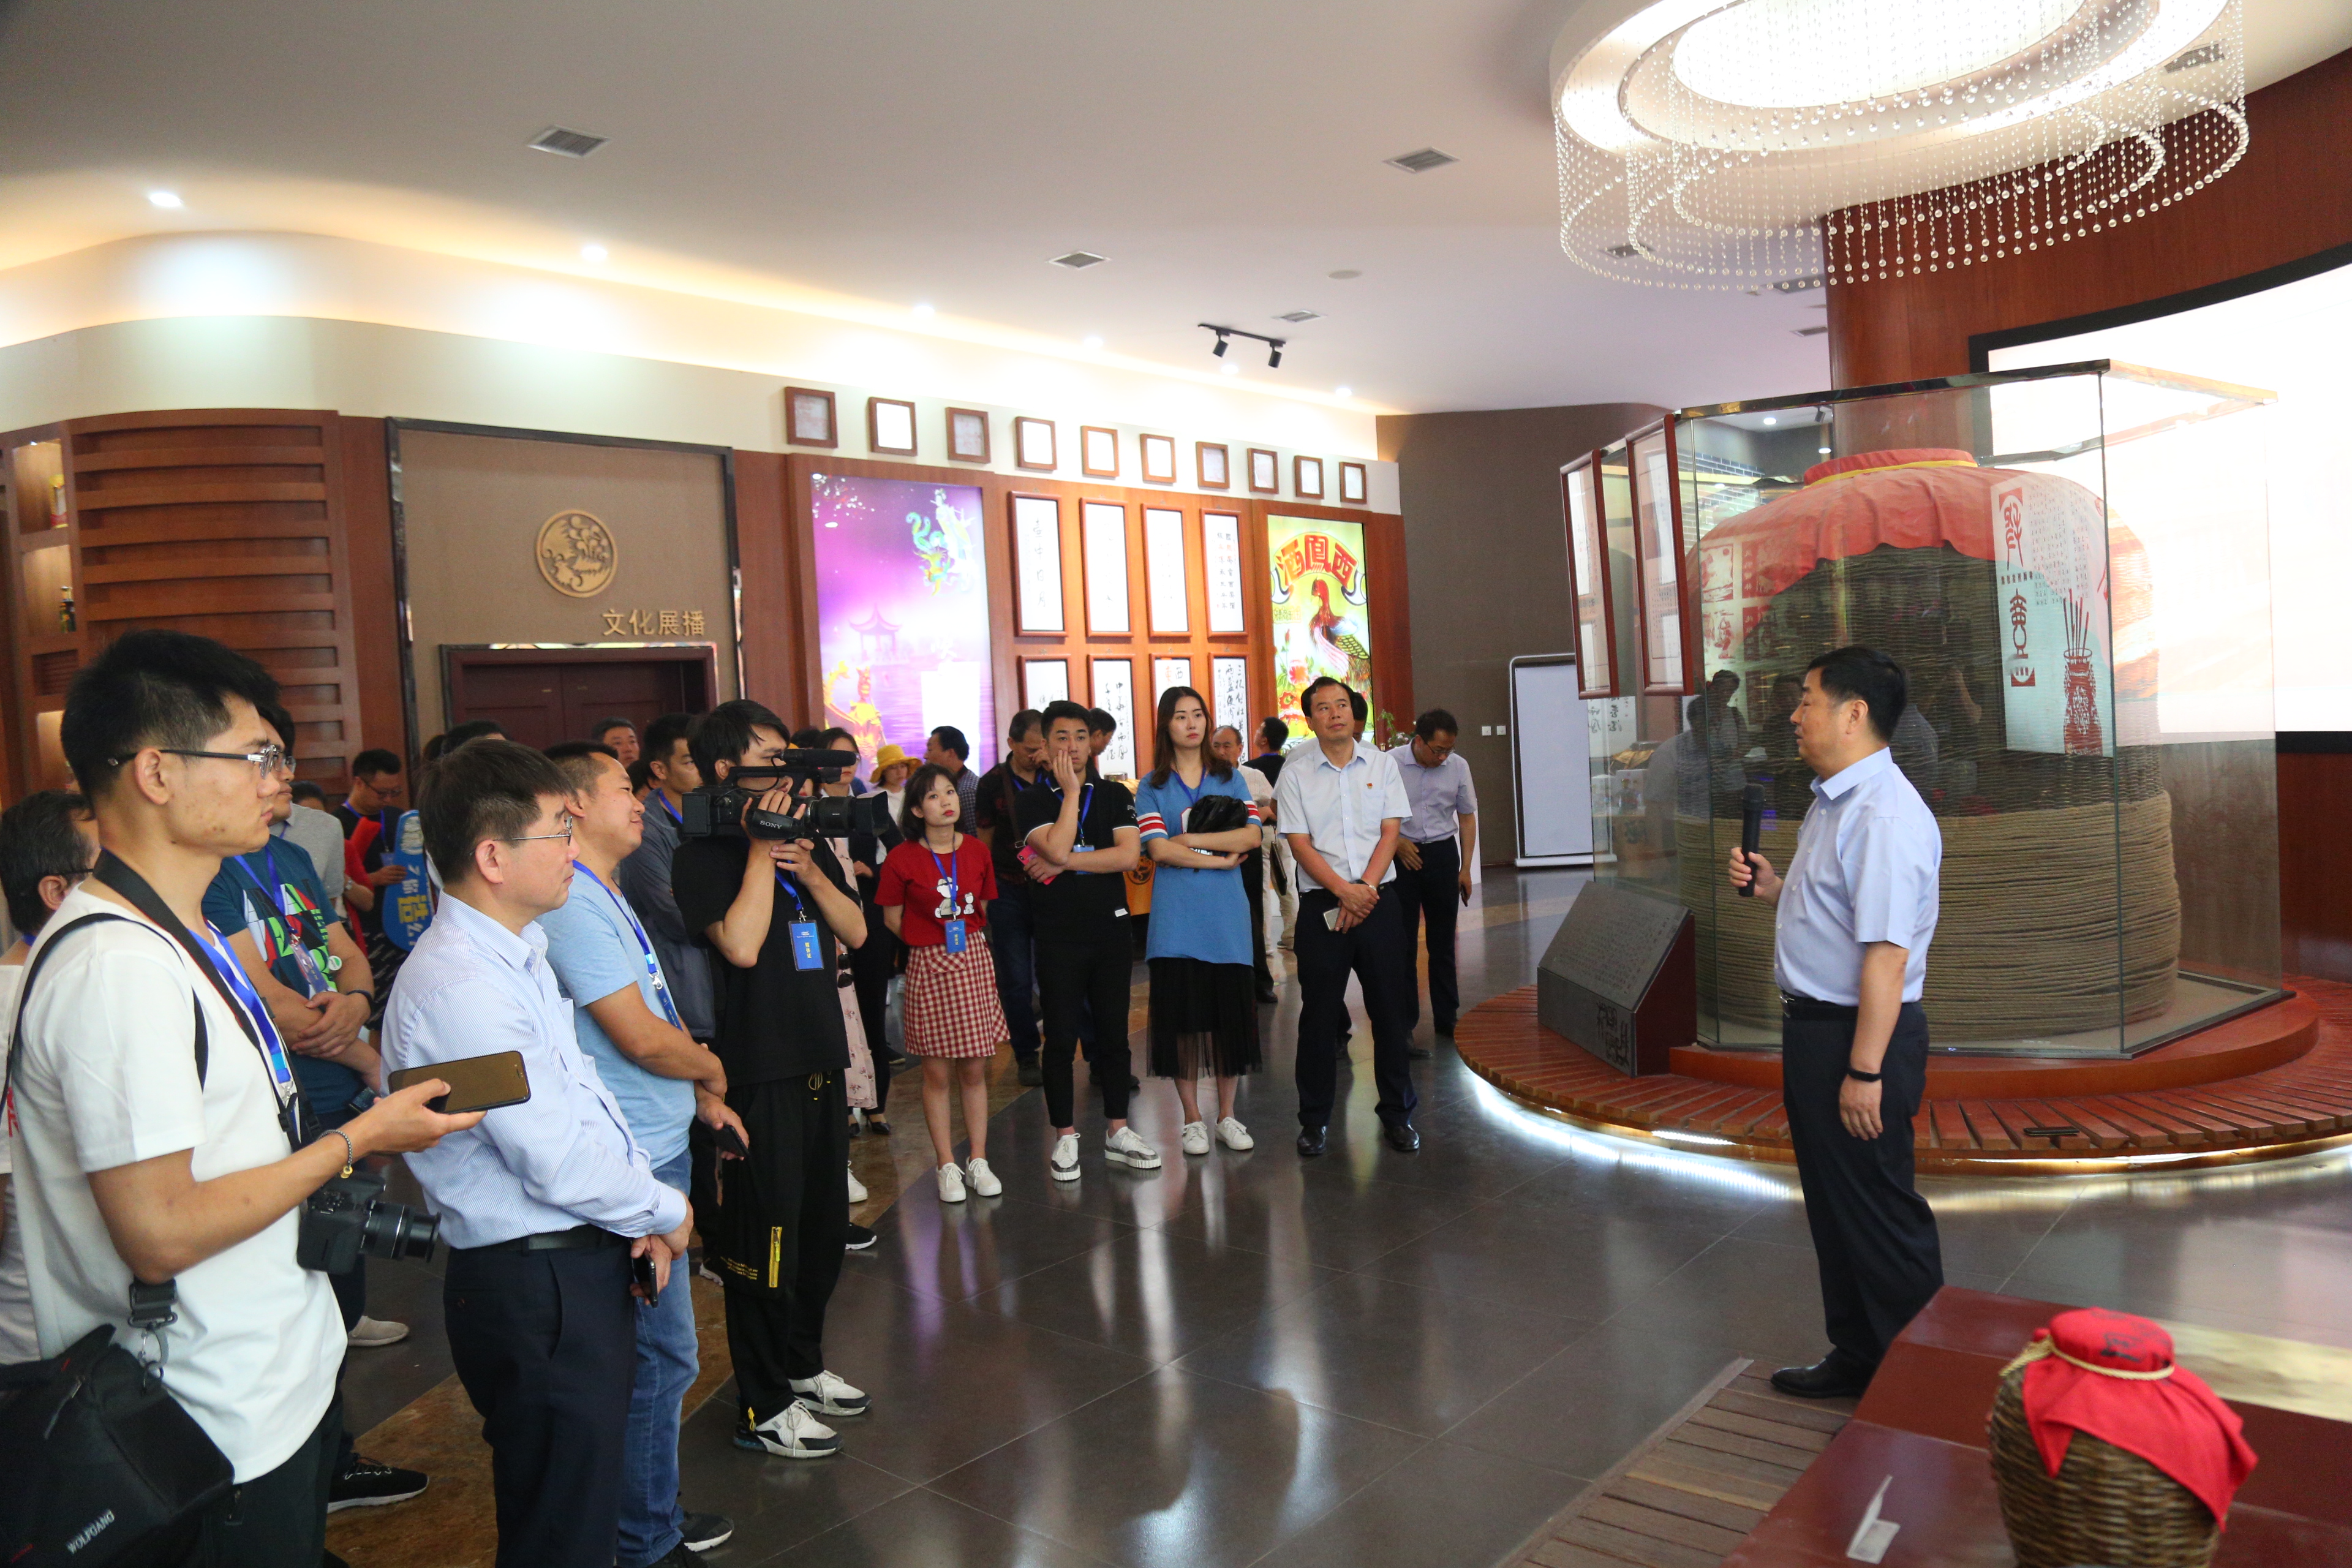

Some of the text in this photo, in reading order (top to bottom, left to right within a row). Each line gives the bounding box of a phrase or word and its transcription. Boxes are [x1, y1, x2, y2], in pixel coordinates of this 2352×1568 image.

[602, 608, 705, 636] 文化展播
[760, 820, 783, 829] SONY
[65, 1509, 116, 1556] WOLFGANG
